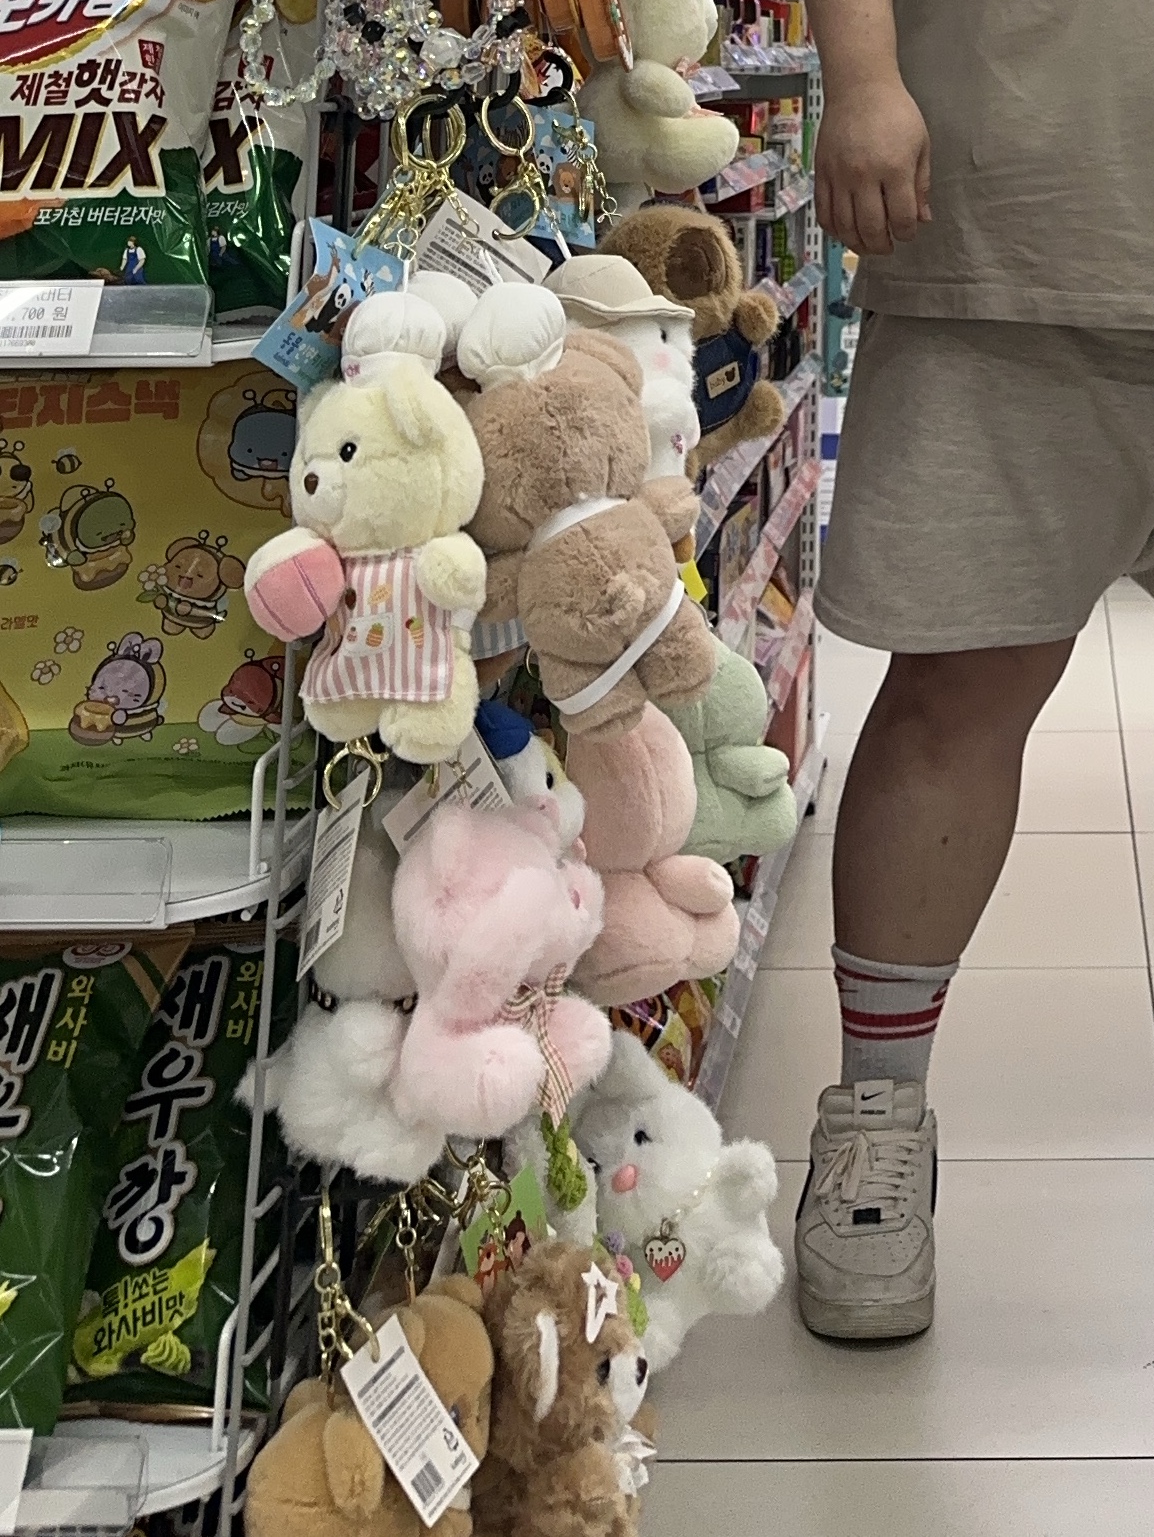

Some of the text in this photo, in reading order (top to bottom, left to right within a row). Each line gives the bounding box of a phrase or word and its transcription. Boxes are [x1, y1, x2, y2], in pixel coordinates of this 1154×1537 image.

[34, 206, 167, 227] 포카칩 버터감자맛
[206, 201, 250, 218] 감자맛
[46, 974, 95, 1070] 와사비
[107, 959, 224, 1256] 새우깡
[91, 1290, 187, 1357] 와사비맛
